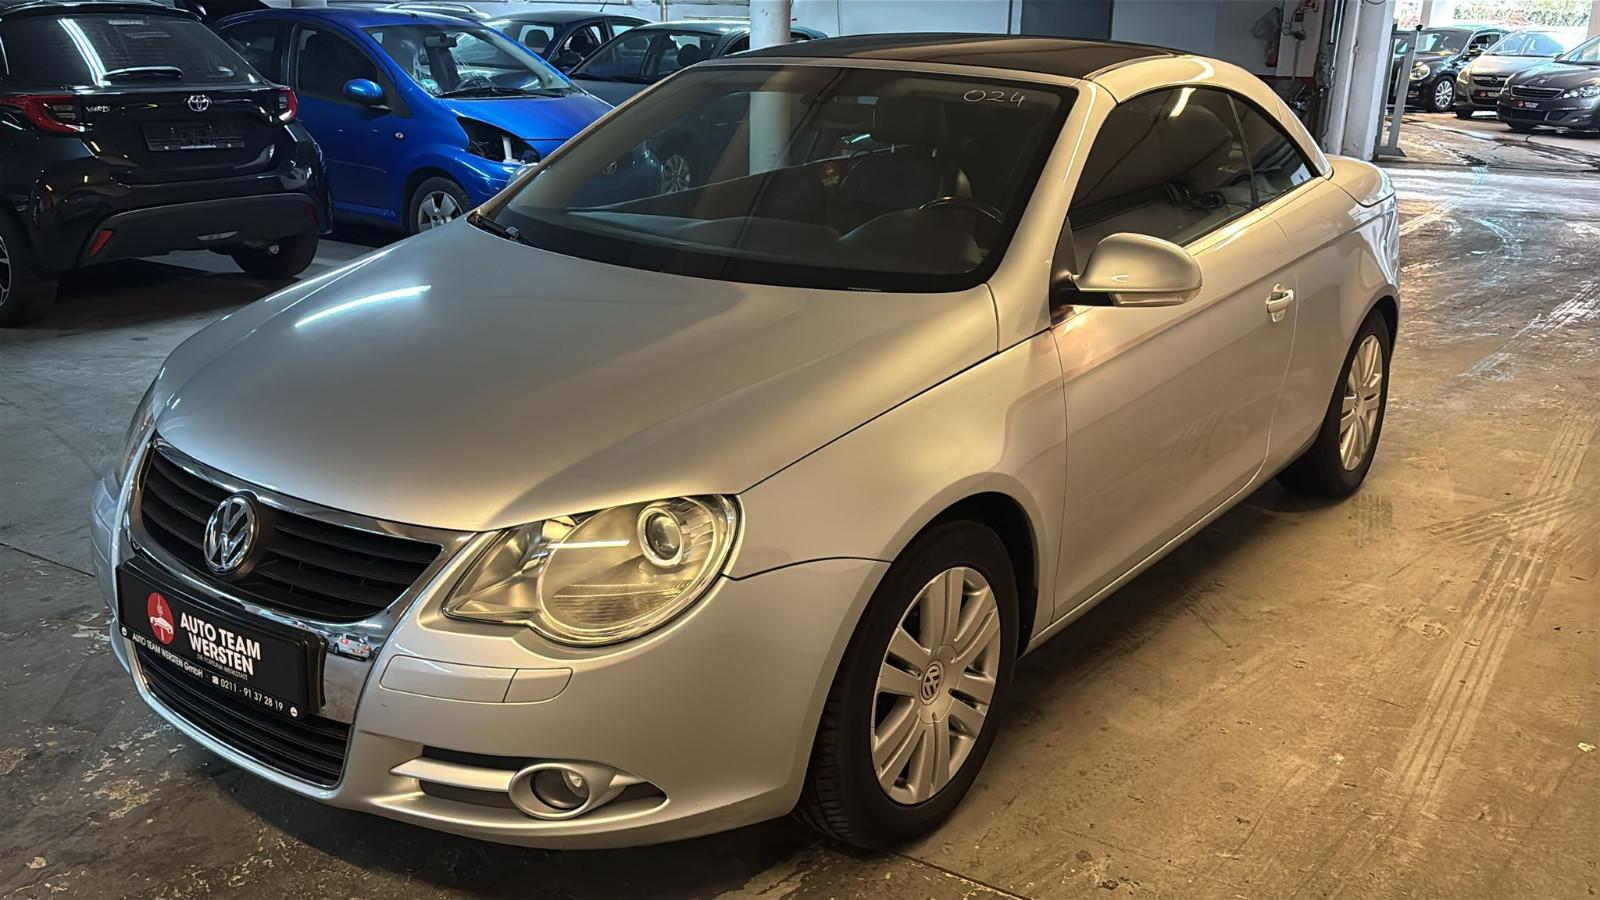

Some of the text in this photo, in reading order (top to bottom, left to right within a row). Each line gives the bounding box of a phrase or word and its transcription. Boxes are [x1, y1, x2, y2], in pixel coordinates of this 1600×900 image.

[963, 89, 1026, 108] 024
[181, 612, 261, 660] AUTO TEAM
[188, 632, 254, 675] WERSTEN
[132, 633, 146, 646] AUTO
[147, 640, 160, 654] TEAM
[161, 648, 183, 667] WERSTEN
[183, 662, 204, 678] GmbH
[220, 679, 237, 692] 0211
[243, 688, 252, 698] 91
[254, 692, 262, 702] 37
[264, 696, 273, 707] 28
[275, 700, 283, 711] 19
